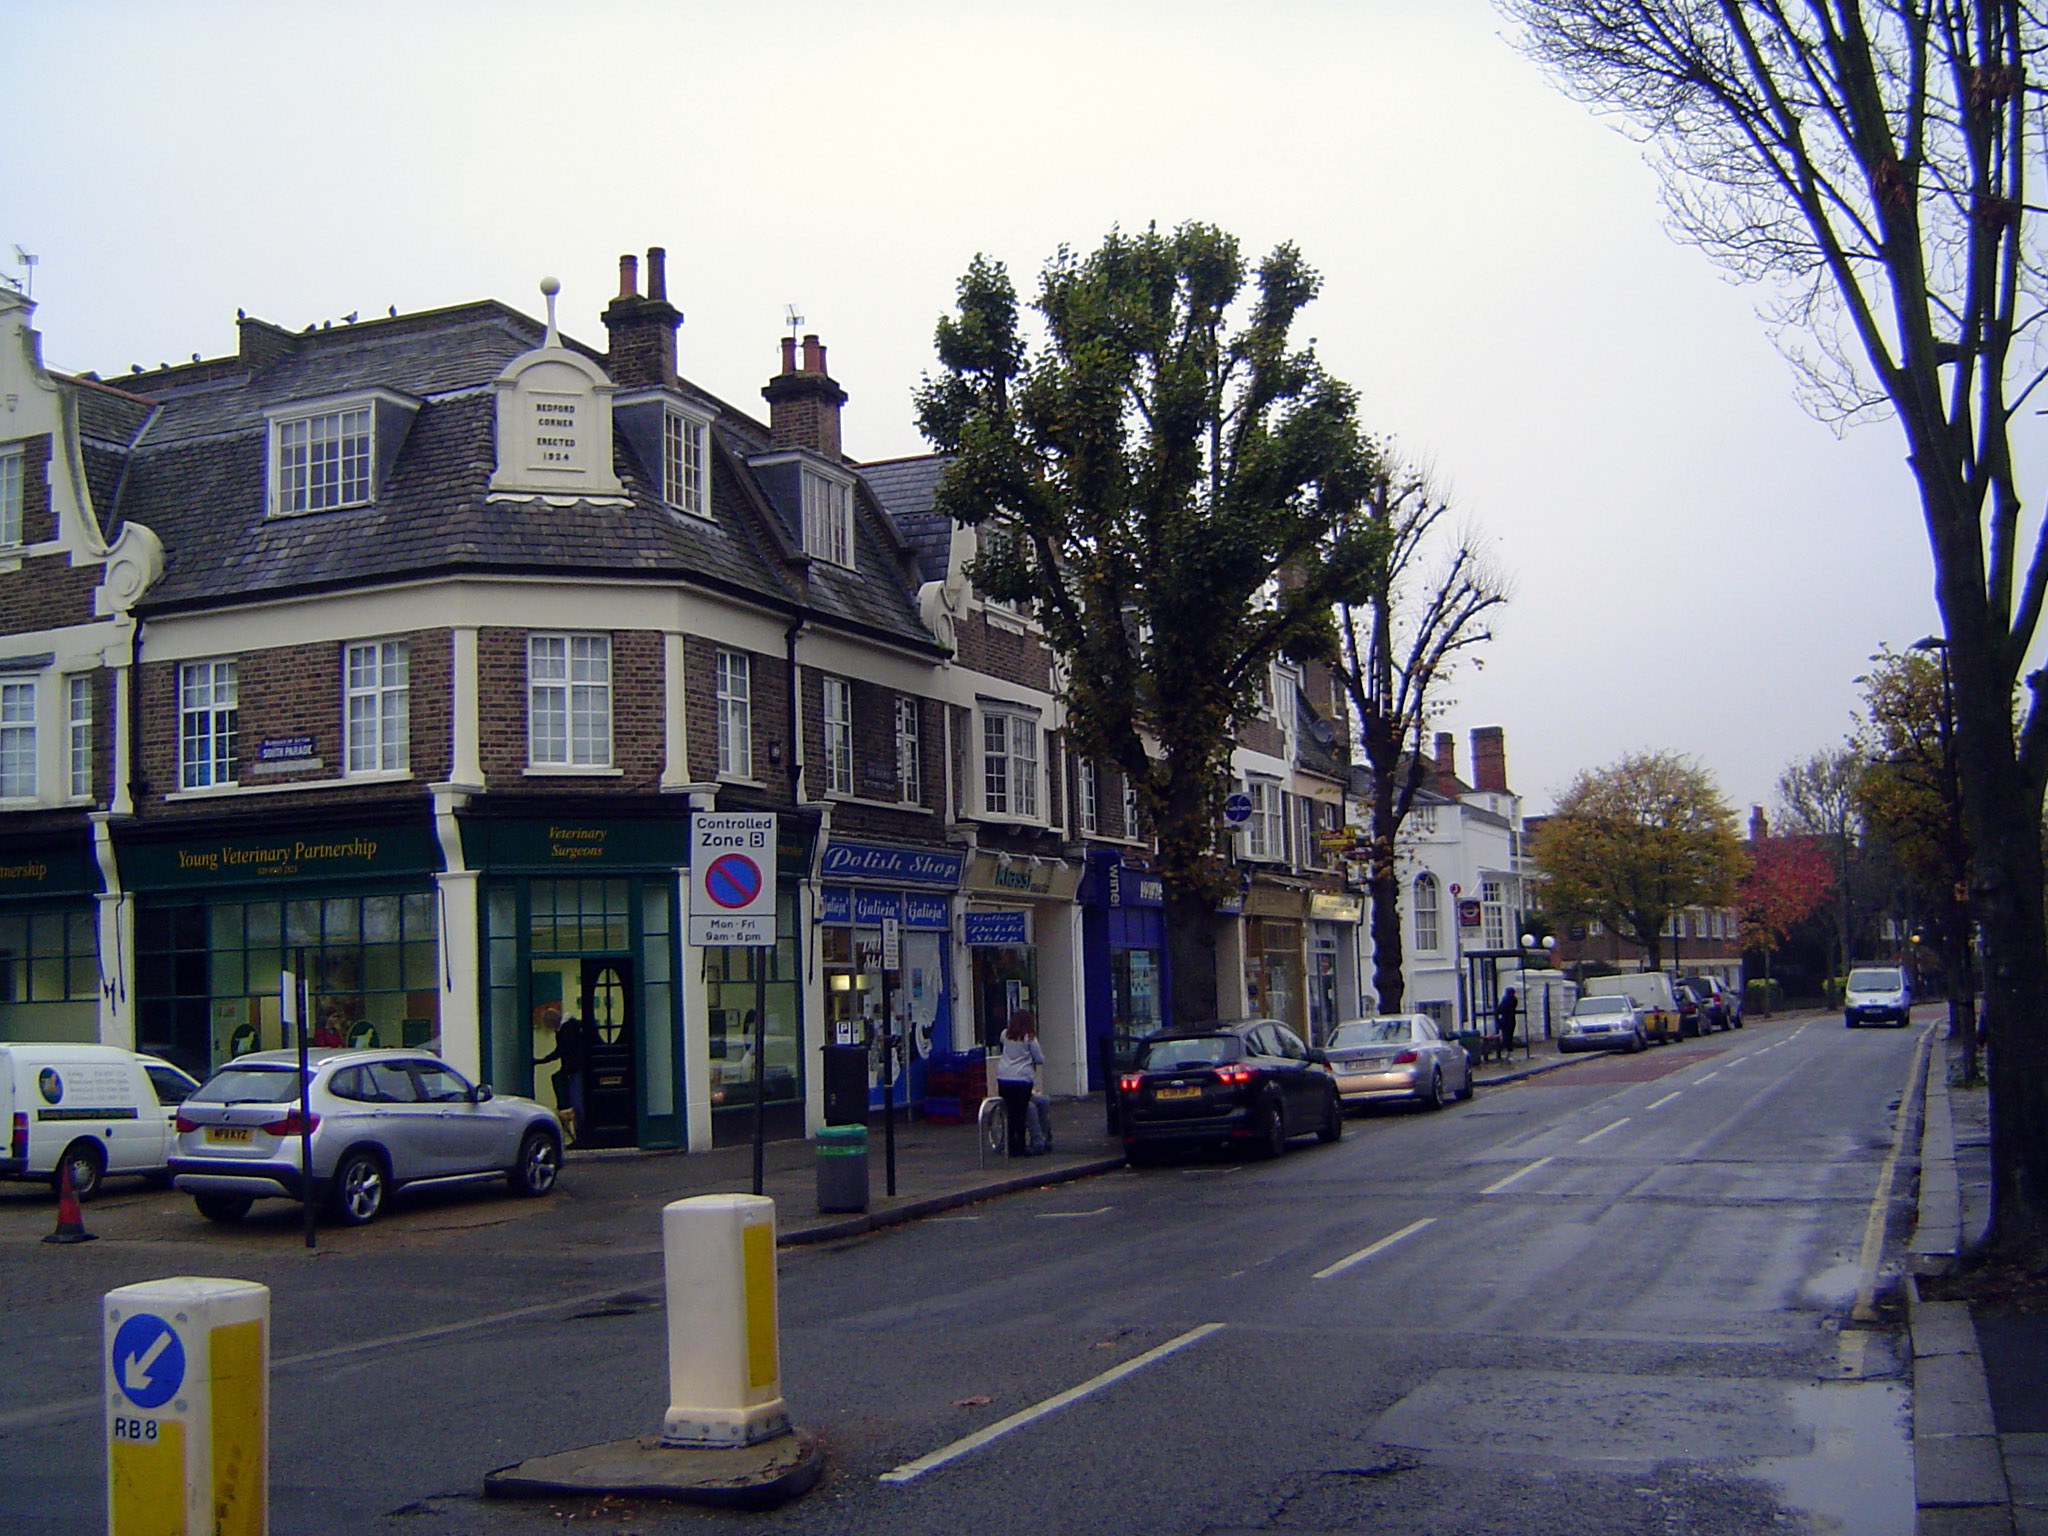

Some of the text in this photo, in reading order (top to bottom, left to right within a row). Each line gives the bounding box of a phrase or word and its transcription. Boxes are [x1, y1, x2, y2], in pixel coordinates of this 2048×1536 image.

[536, 404, 575, 413] BEDFORD
[538, 418, 574, 427] CORNER
[536, 438, 576, 447] ERECTED
[543, 452, 569, 461] 1924
[263, 744, 313, 759] SOUTH PARADE
[696, 818, 772, 829] Controlled
[549, 826, 607, 842] Veterinary
[701, 833, 764, 848] Zone B
[178, 837, 377, 871] Young Veterinary Partnership
[551, 844, 604, 859] Surgeons
[826, 847, 902, 870] Polish
[909, 855, 957, 878] Shop
[710, 921, 733, 929] Mon
[741, 920, 755, 929] Fri
